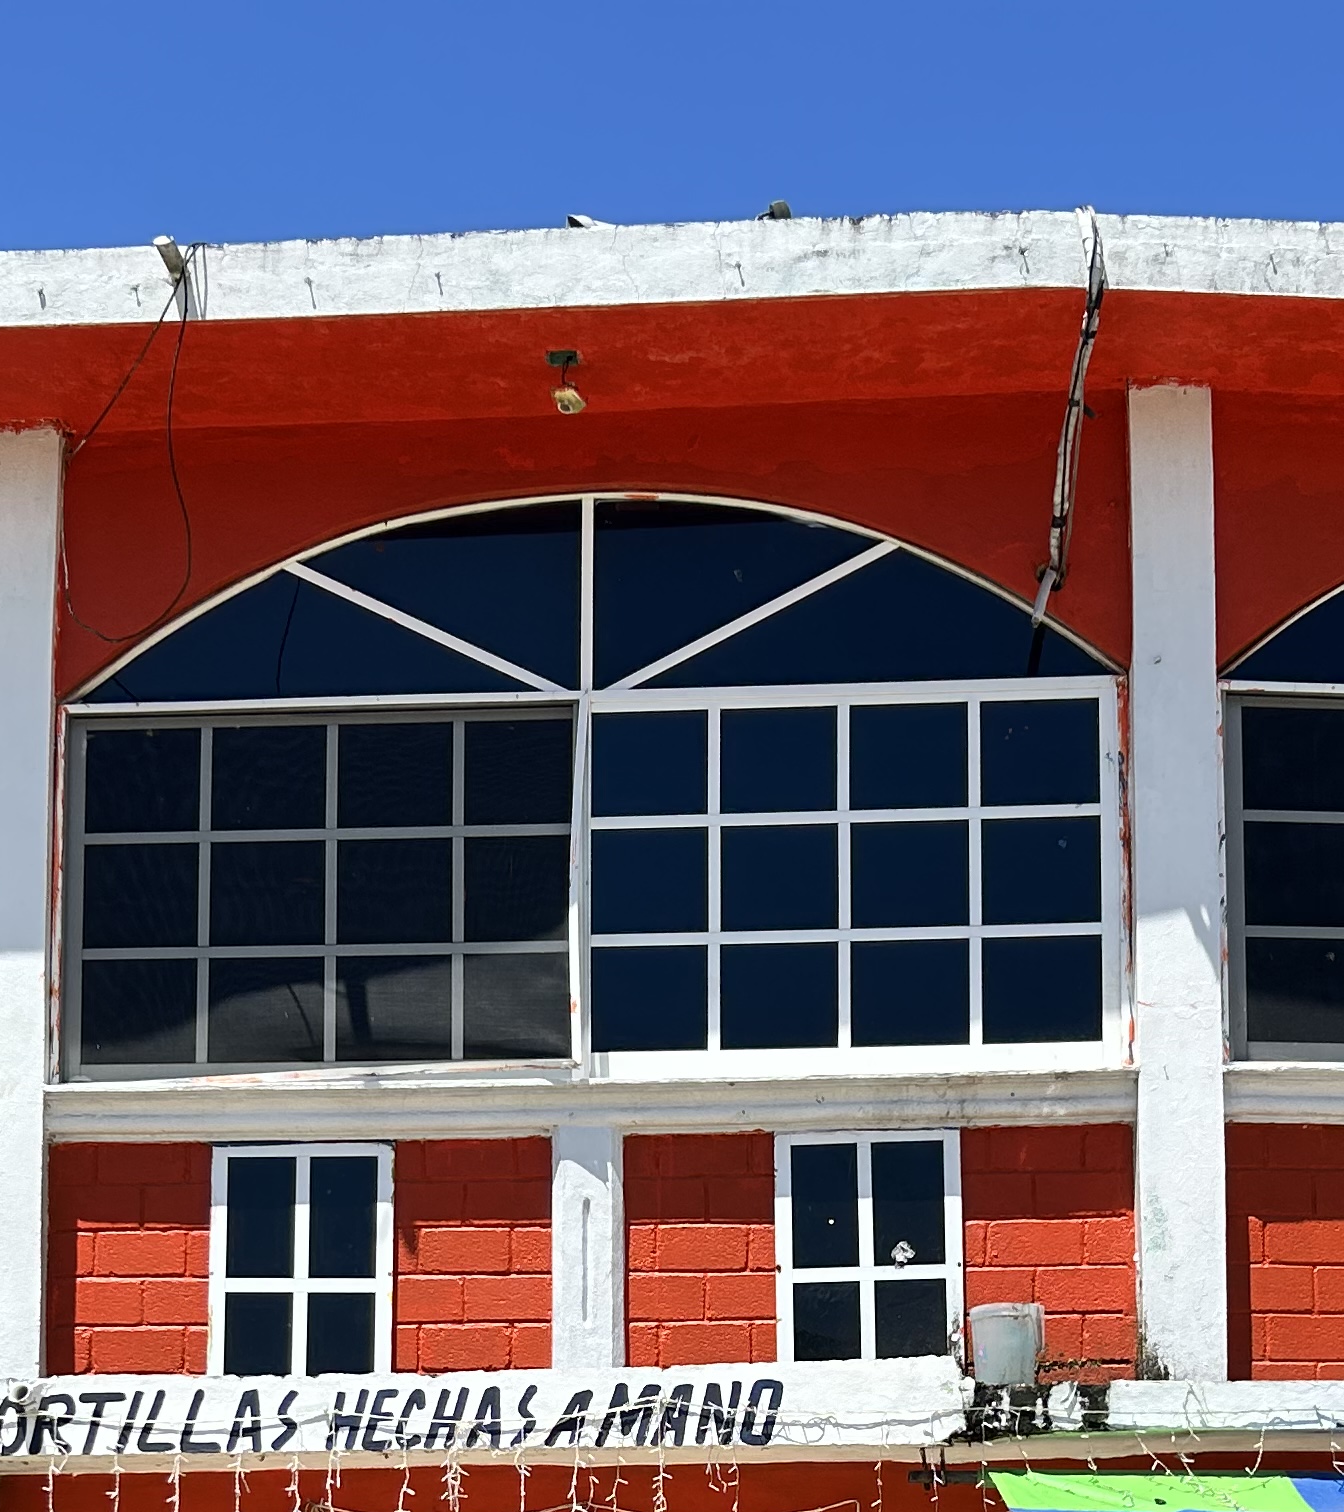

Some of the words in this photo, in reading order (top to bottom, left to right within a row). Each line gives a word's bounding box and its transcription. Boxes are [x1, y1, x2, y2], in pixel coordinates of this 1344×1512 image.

[325, 1386, 538, 1453] HECHAS
[545, 1389, 593, 1448] A
[593, 1378, 784, 1448] MANO
